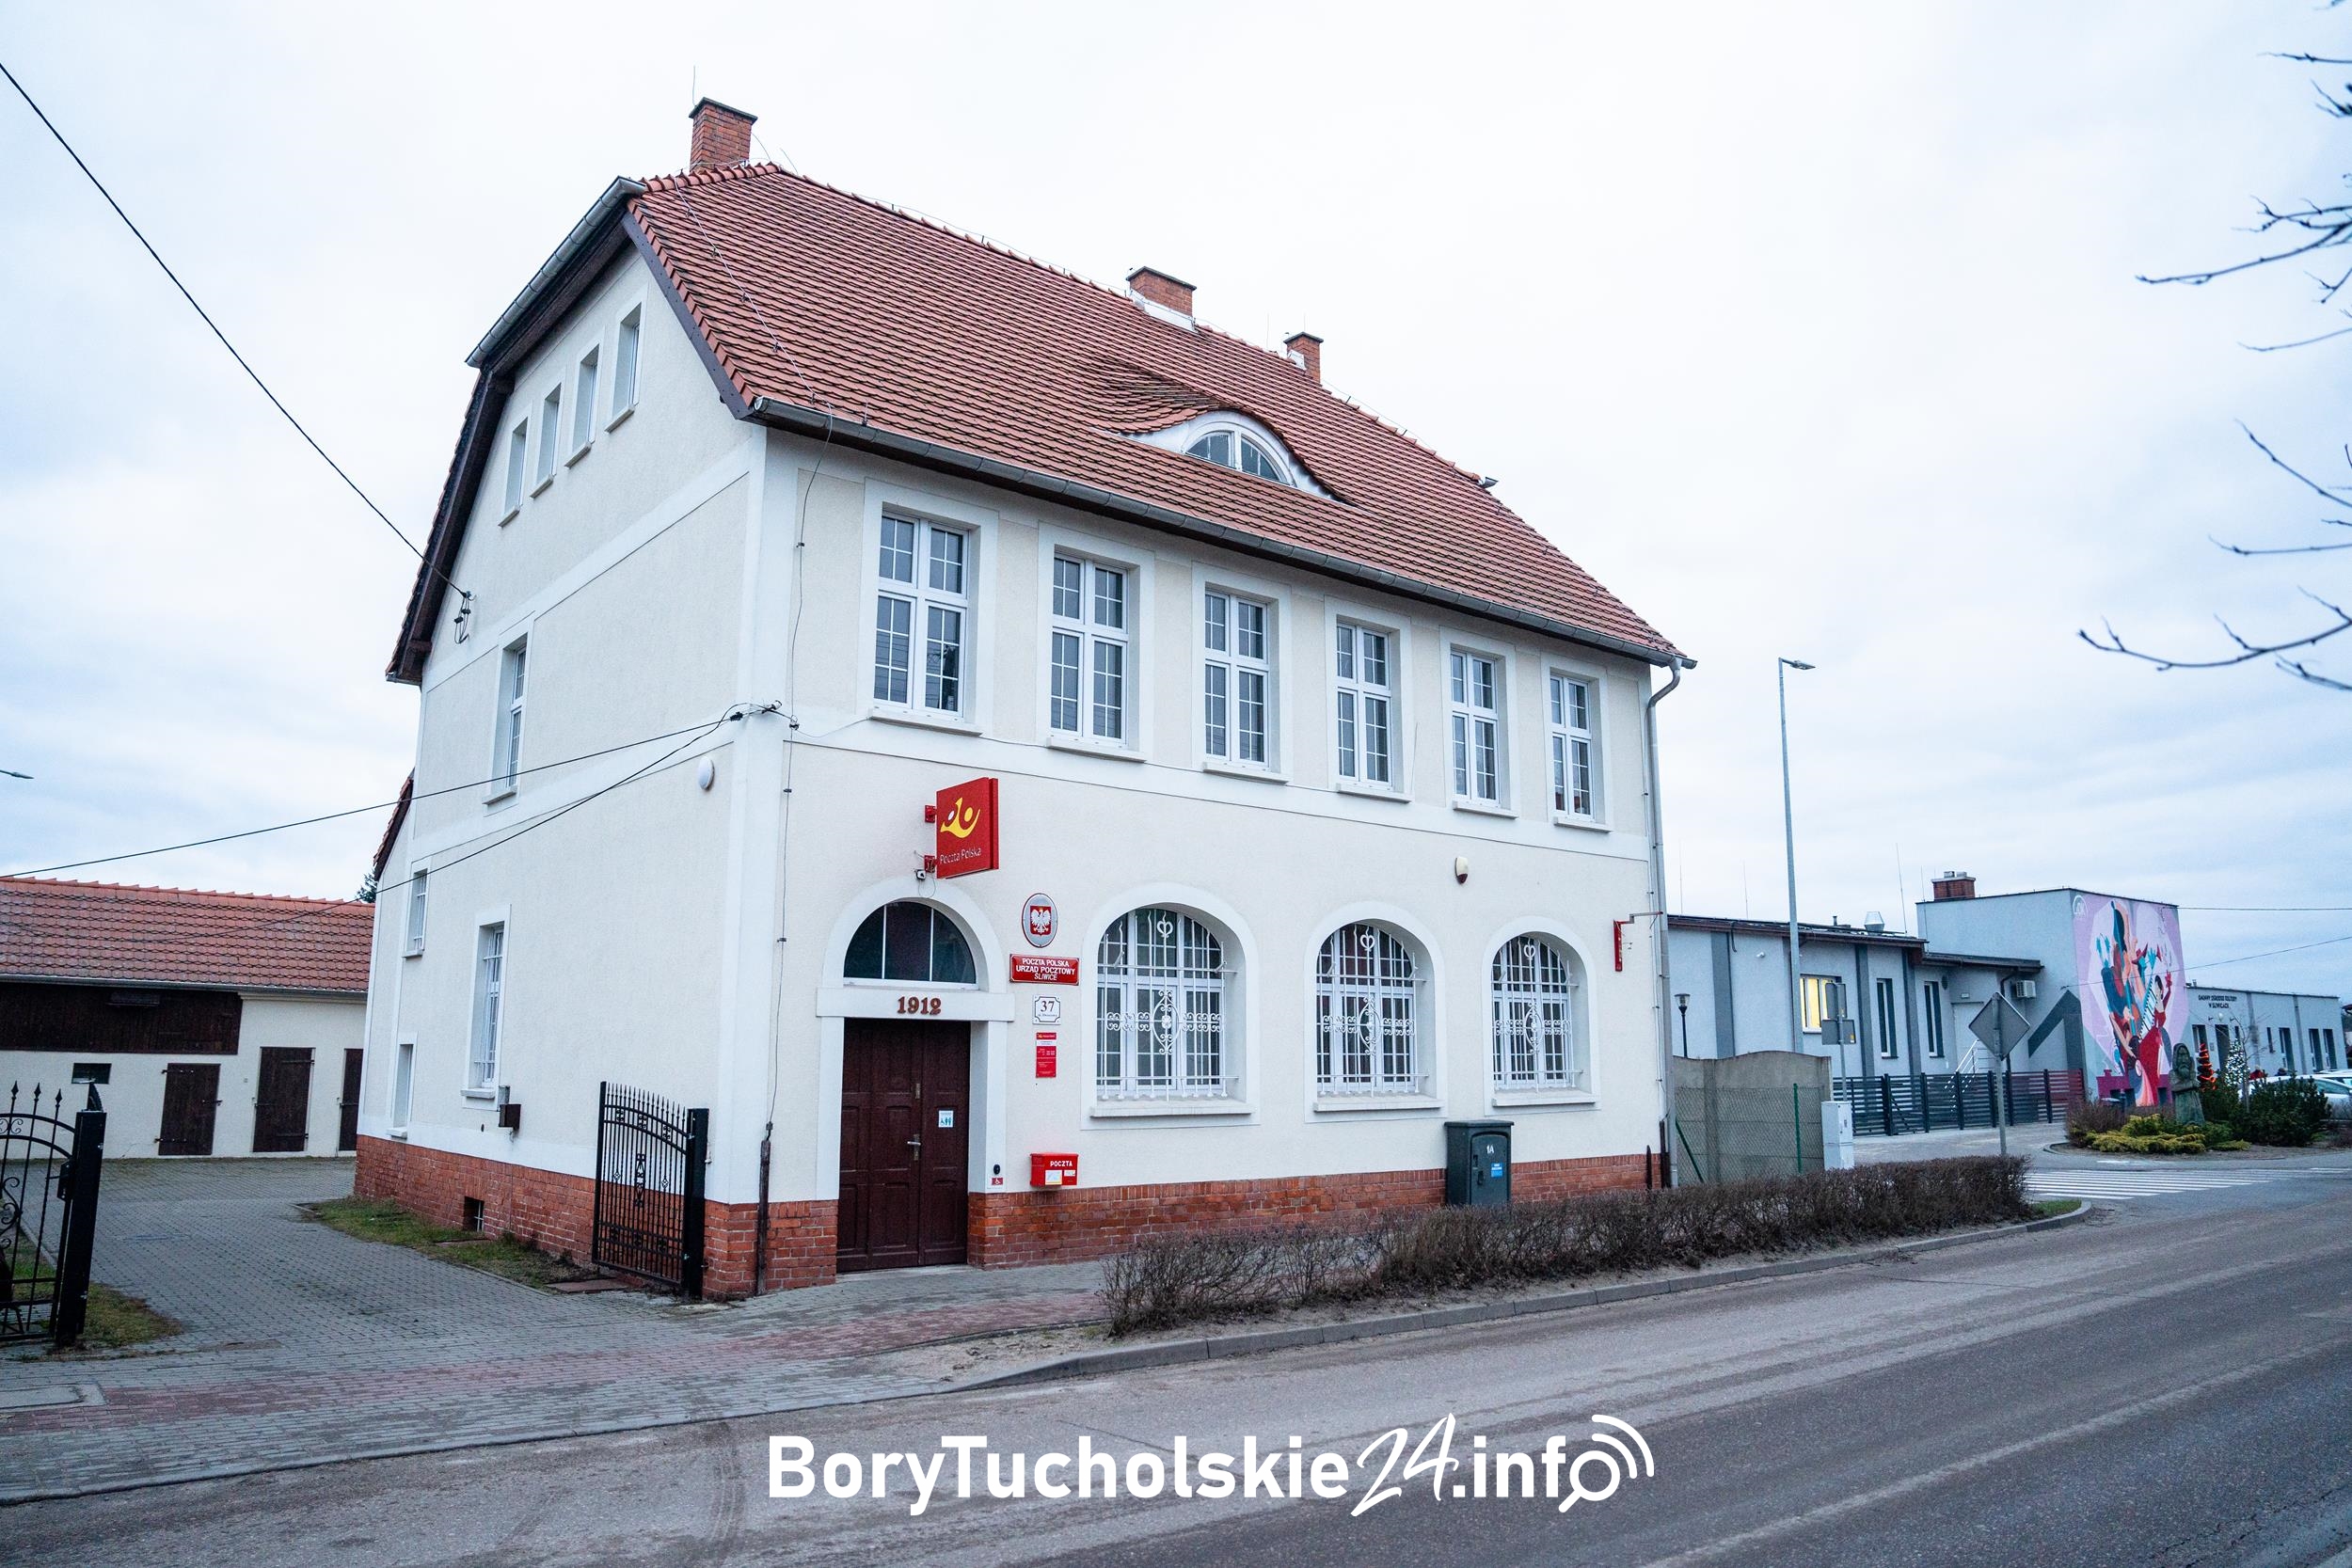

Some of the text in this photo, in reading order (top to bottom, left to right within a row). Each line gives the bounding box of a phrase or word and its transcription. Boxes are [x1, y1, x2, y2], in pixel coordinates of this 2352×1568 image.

[940, 847, 981, 864] Poczta Polska
[1022, 958, 1045, 966] POCZTA
[1041, 966, 1075, 975] POCZTOWY
[897, 995, 942, 1016] 1912
[1040, 1000, 1056, 1013] 37
